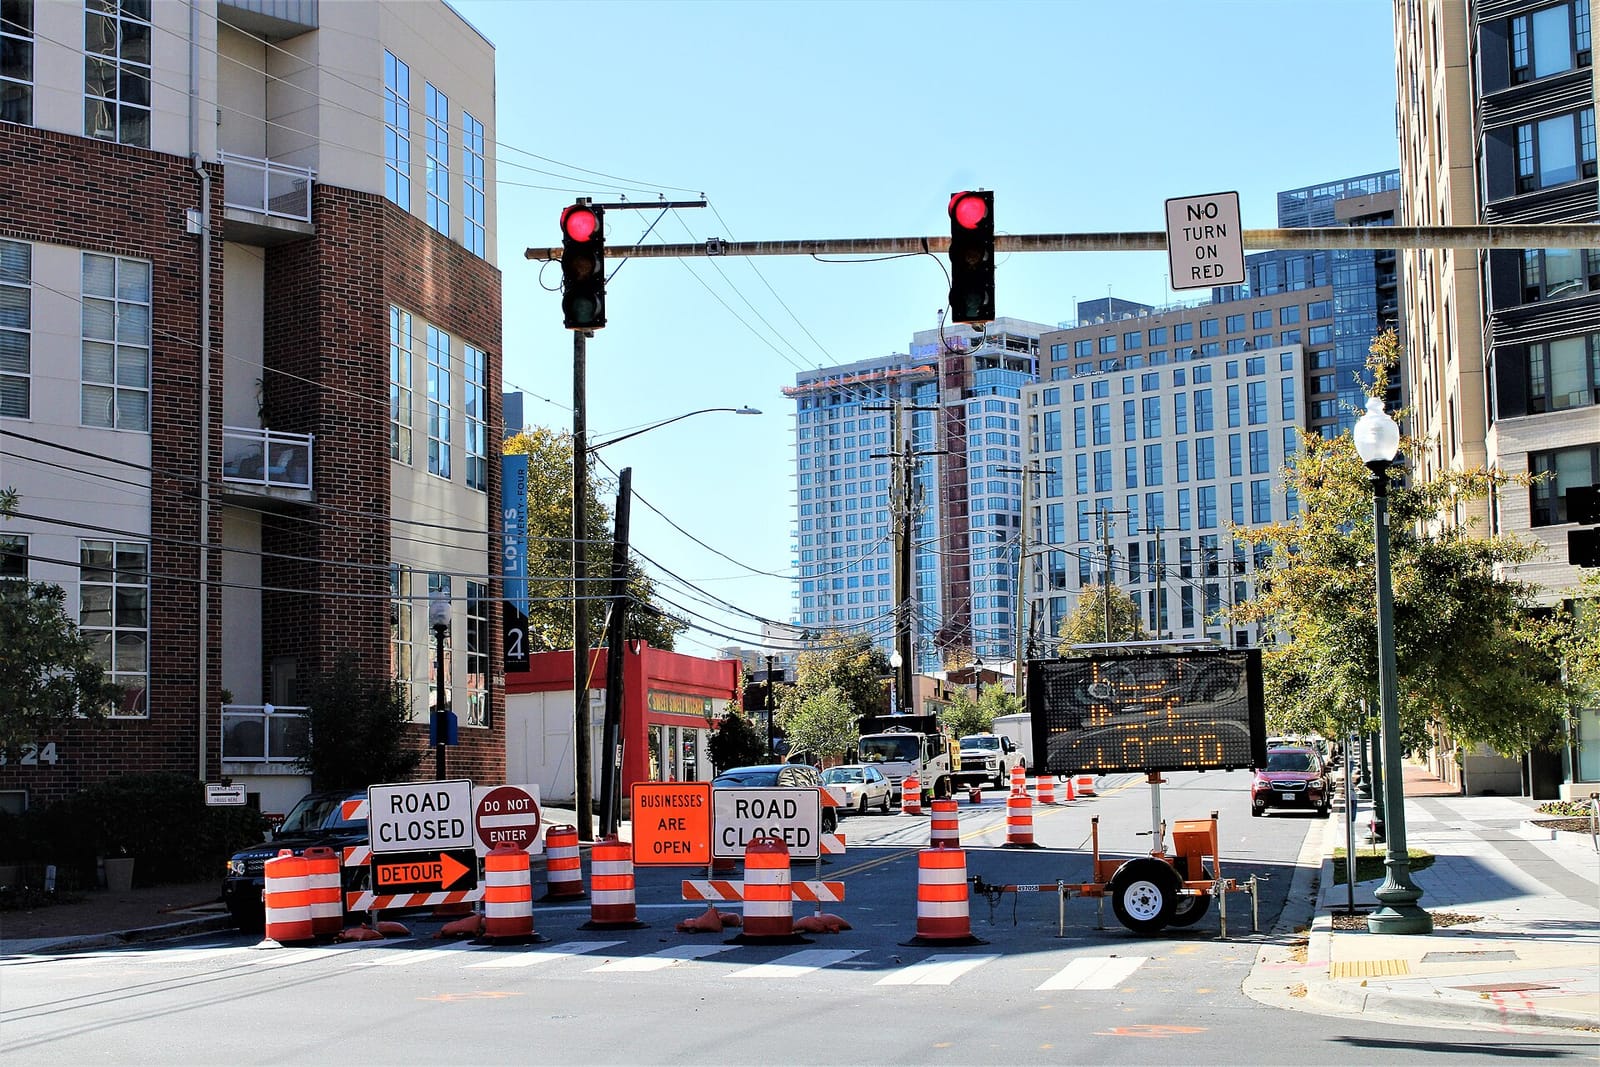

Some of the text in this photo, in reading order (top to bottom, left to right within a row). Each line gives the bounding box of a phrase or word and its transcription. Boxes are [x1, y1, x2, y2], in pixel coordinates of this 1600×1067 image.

[1187, 202, 1218, 221] NO
[1182, 224, 1226, 241] TURN
[1195, 244, 1217, 260] ON
[1191, 264, 1223, 280] RED
[505, 508, 517, 570] LOFTS
[20, 742, 58, 766] 24
[391, 792, 450, 814] ROAD
[484, 799, 529, 812] DO NOT
[641, 794, 702, 808] BUSINESSES
[736, 799, 797, 819] ROAD
[379, 819, 464, 843] CLOSED
[658, 818, 686, 831] ARE
[490, 829, 526, 842] ENTER
[722, 827, 810, 848] CLOSED
[653, 841, 691, 854] OPEN
[382, 863, 442, 882] DETOUR
